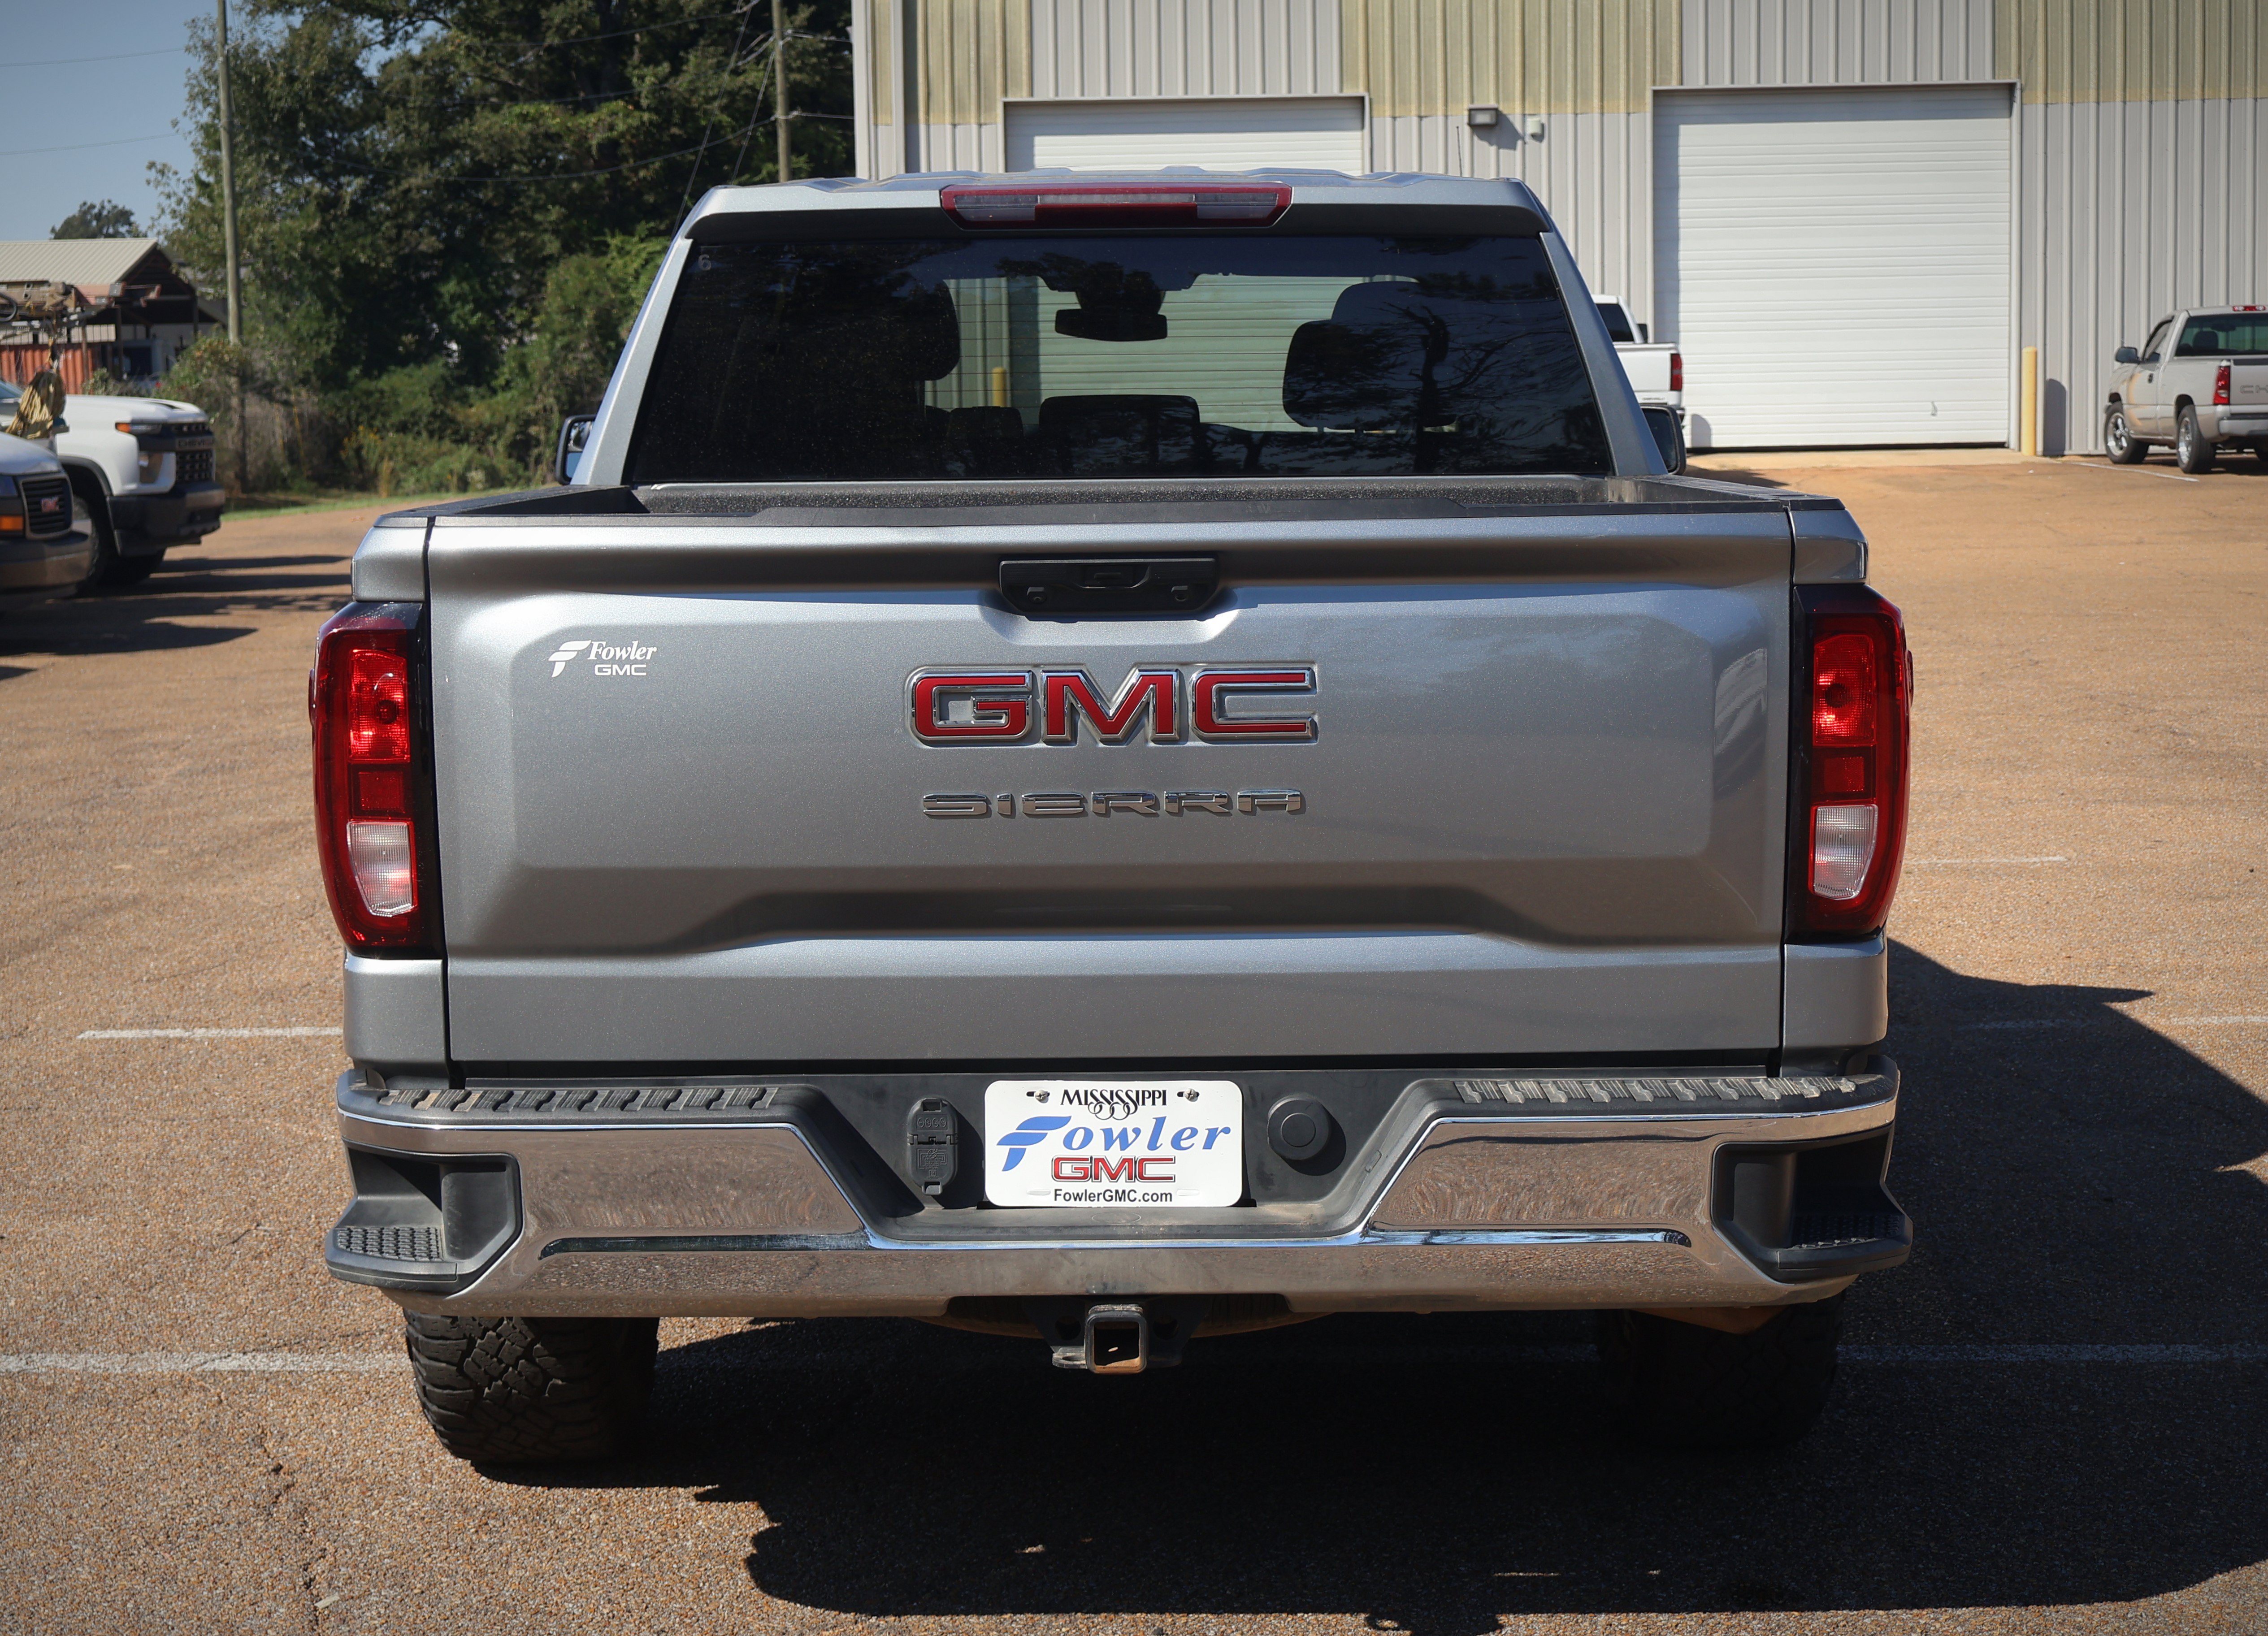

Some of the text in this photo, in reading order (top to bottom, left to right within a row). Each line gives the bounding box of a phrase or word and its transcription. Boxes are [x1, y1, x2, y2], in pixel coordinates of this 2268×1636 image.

[587, 641, 657, 660] Fowler
[594, 664, 647, 676] GMC
[910, 668, 1314, 742] GMC
[923, 790, 1304, 816] SIERRA
[1060, 1089, 1167, 1121] MISSISSIPPI
[996, 1116, 1232, 1172] Fowler
[1051, 1155, 1176, 1183] GMC
[1054, 1189, 1173, 1203] FowlerGMC.com
